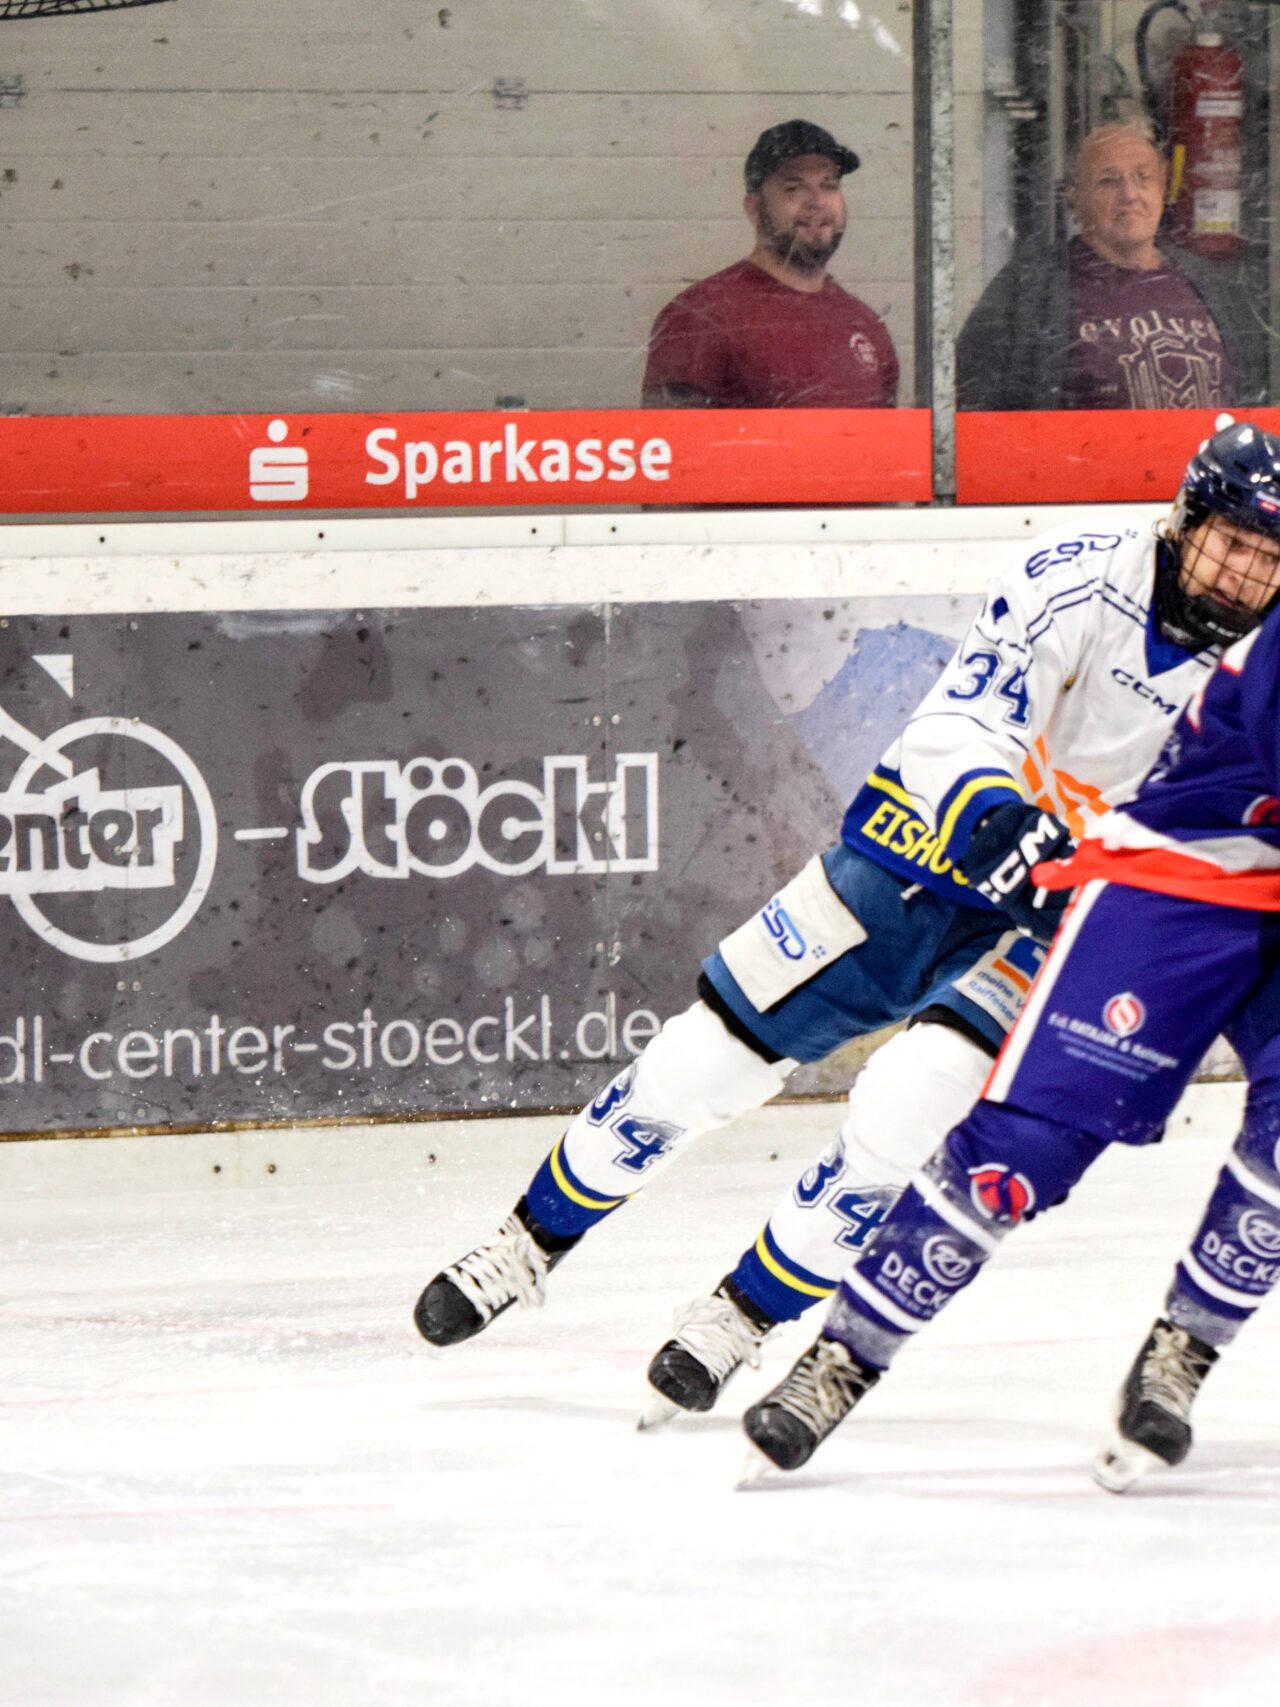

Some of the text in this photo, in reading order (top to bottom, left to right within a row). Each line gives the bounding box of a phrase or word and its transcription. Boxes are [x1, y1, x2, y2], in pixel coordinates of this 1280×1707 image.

[364, 423, 673, 499] Sparkasse
[945, 649, 1034, 731] 34
[1110, 668, 1179, 717] CCM
[0, 794, 166, 874] nter
